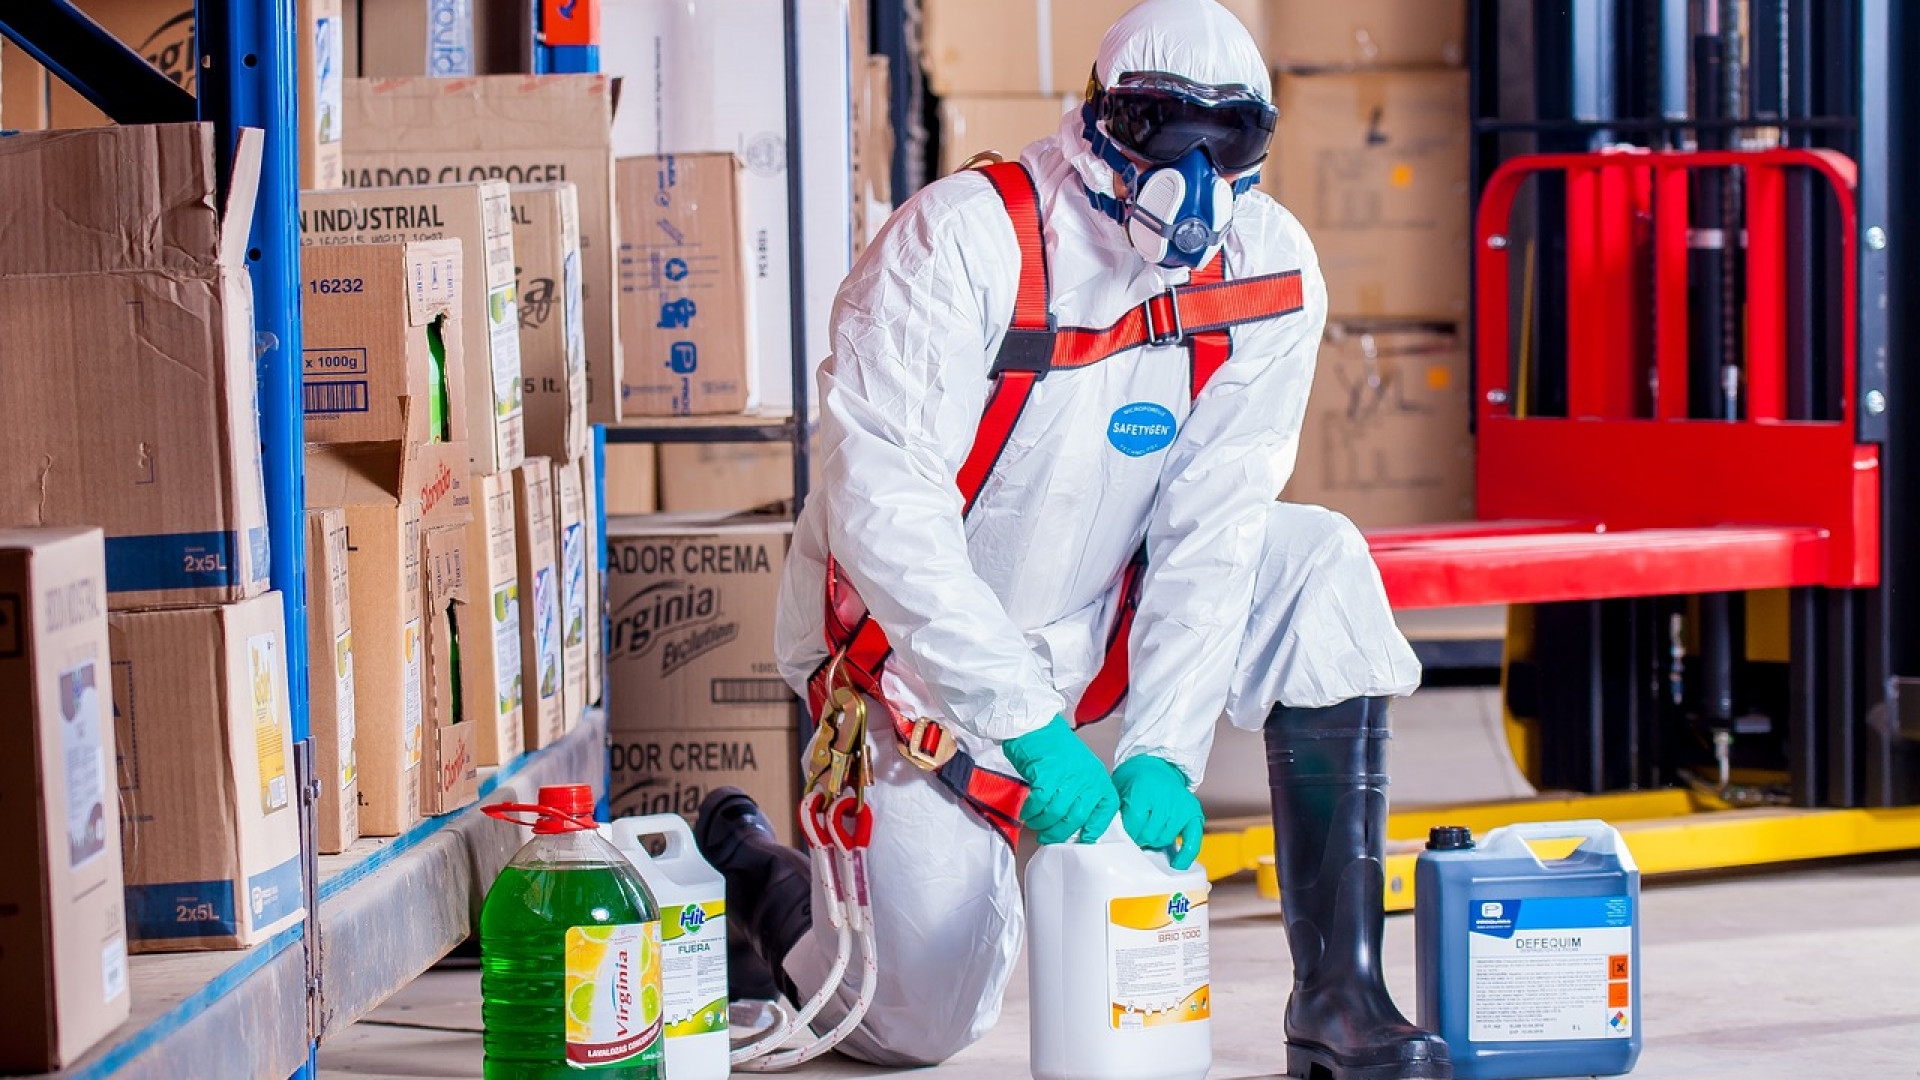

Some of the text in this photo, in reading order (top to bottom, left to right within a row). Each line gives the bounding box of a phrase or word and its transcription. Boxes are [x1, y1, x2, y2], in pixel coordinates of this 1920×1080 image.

[314, 204, 445, 233] INDUSTRIAL
[310, 278, 364, 294] 16232
[318, 356, 358, 371] 1000g
[184, 553, 228, 572] 2x5L
[683, 545, 771, 573] CREMA
[669, 743, 757, 771] CREMA
[176, 902, 220, 922] 2x5L
[1167, 897, 1190, 915] Hit
[680, 908, 706, 927] Hit
[1158, 929, 1201, 942] BRIO 1000
[1516, 937, 1582, 949] DEFEQUIM
[678, 943, 711, 954] FUERA
[614, 949, 632, 1037] Virginia
